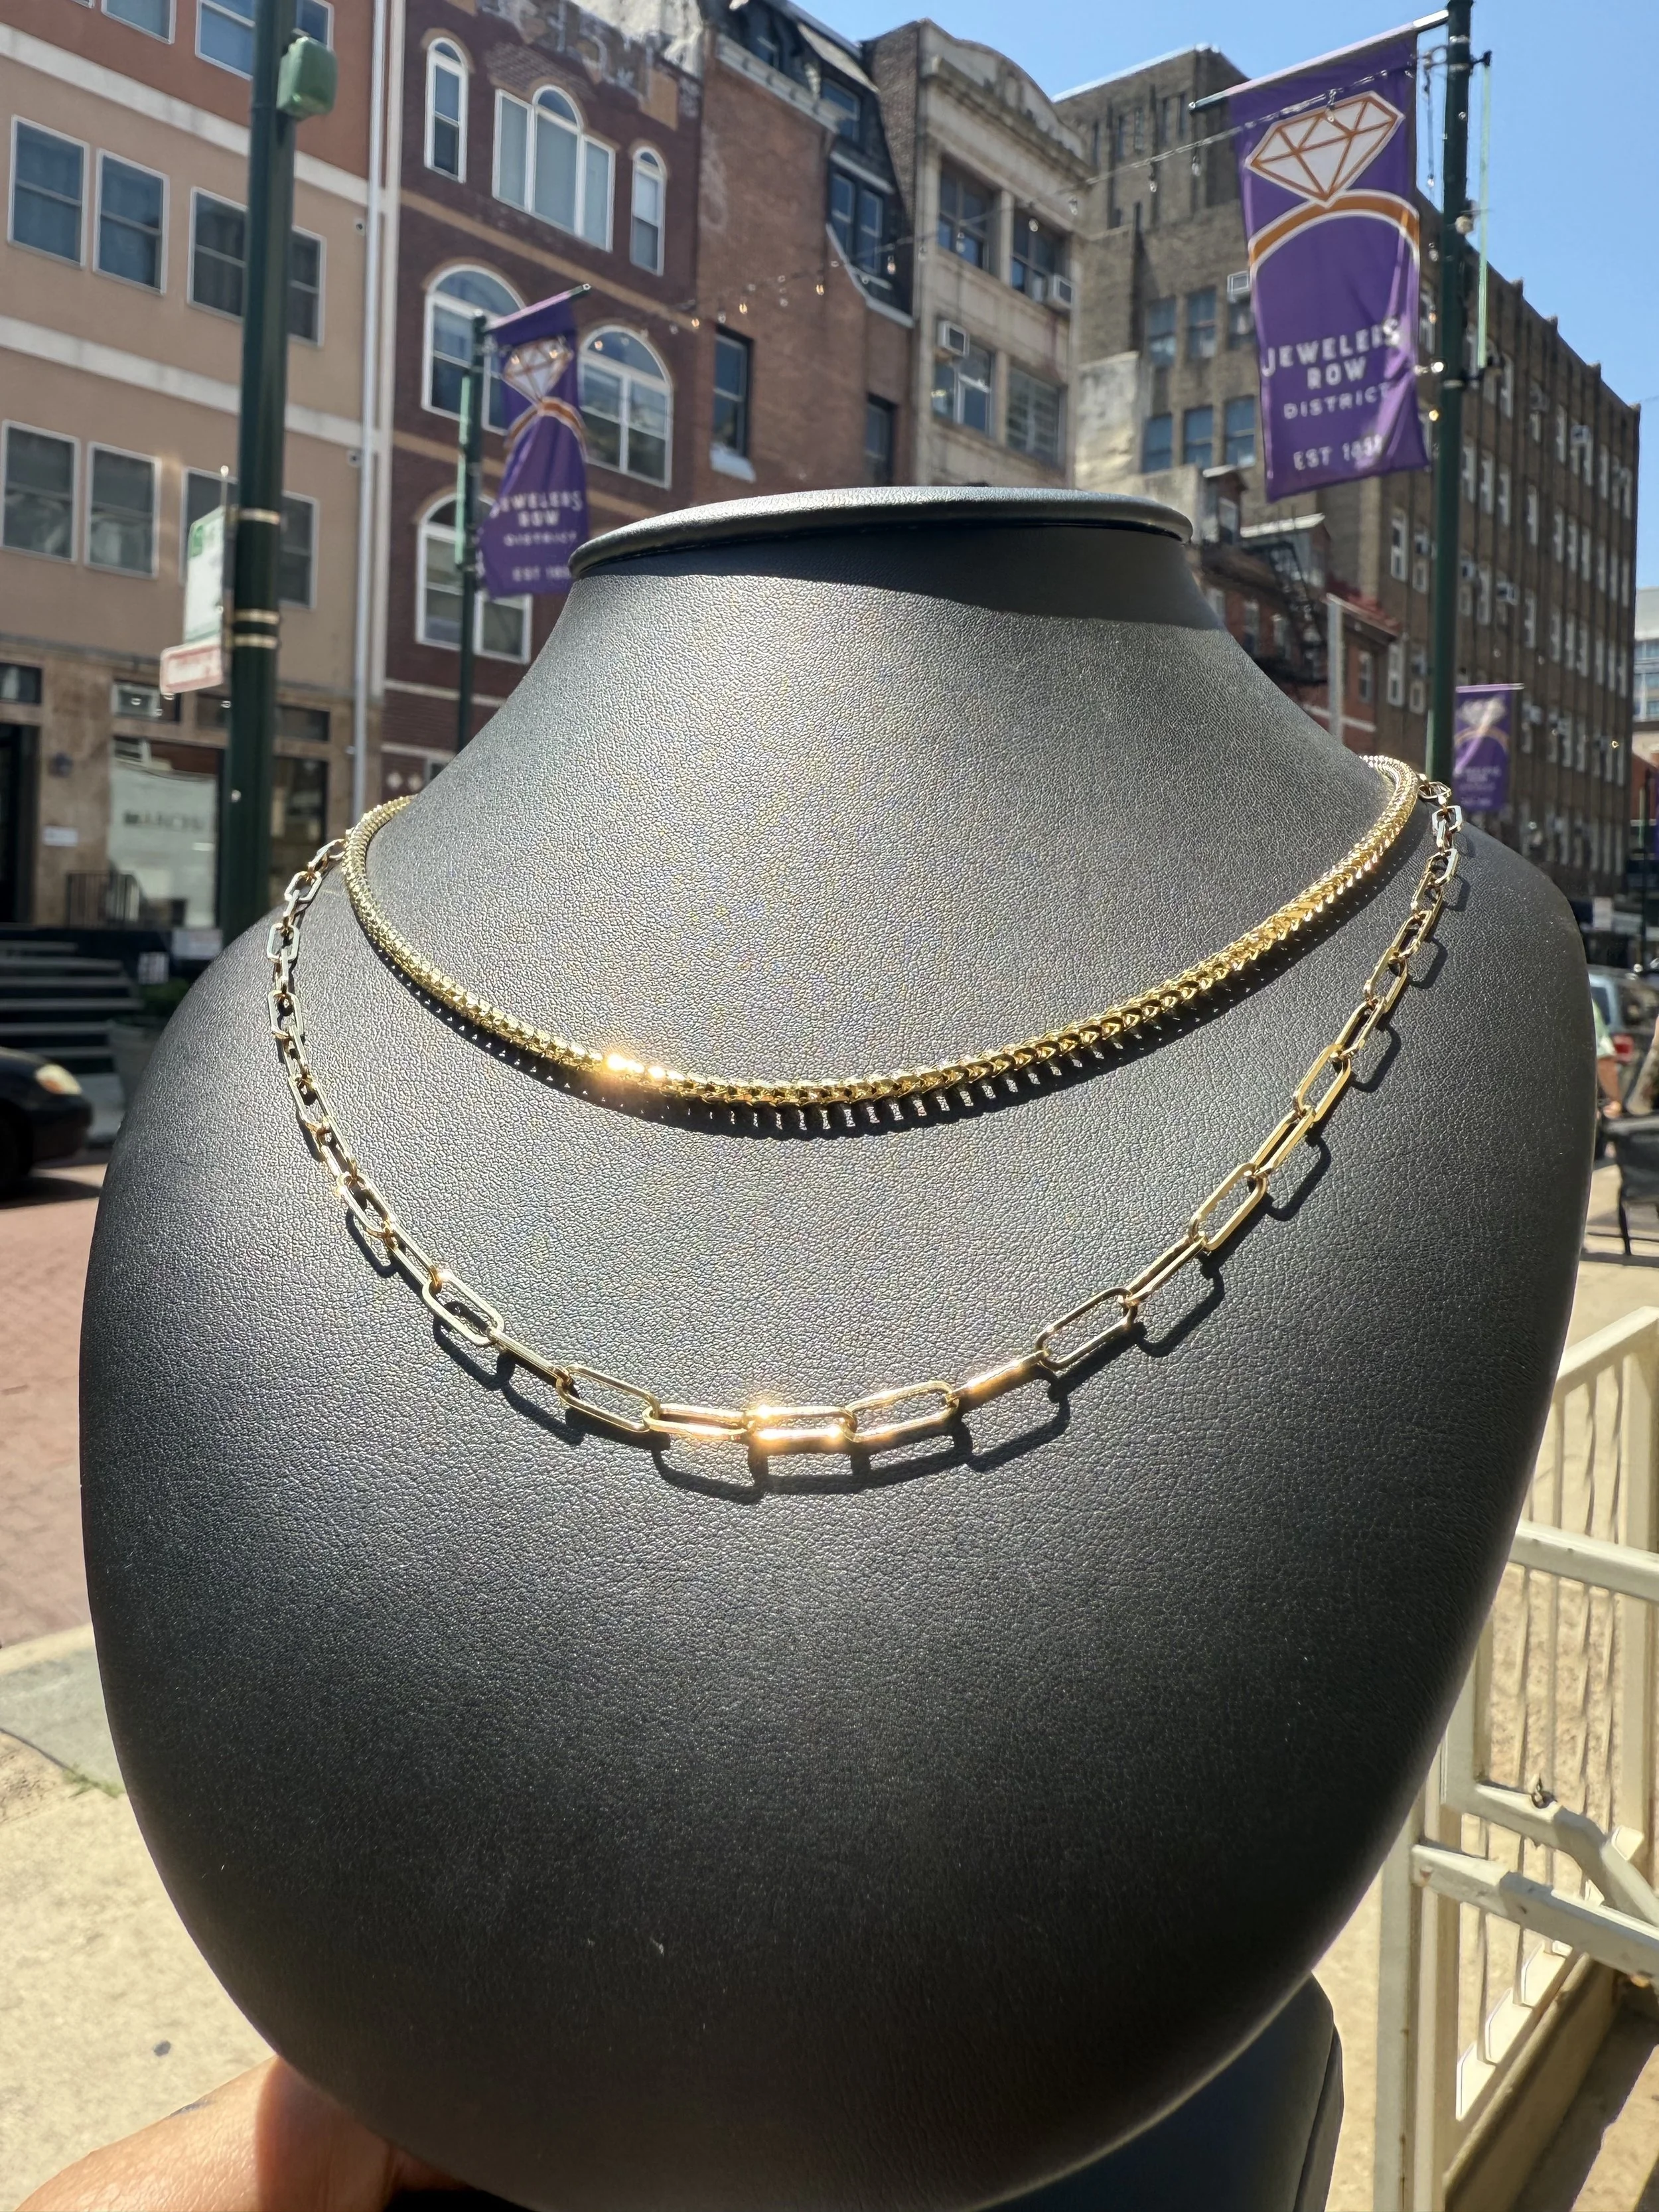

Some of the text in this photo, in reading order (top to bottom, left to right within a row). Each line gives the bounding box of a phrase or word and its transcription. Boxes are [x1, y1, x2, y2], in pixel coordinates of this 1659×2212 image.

[1307, 356, 1366, 390] ROW
[1283, 382, 1391, 419] DISTRICT
[1293, 445, 1332, 471] EST
